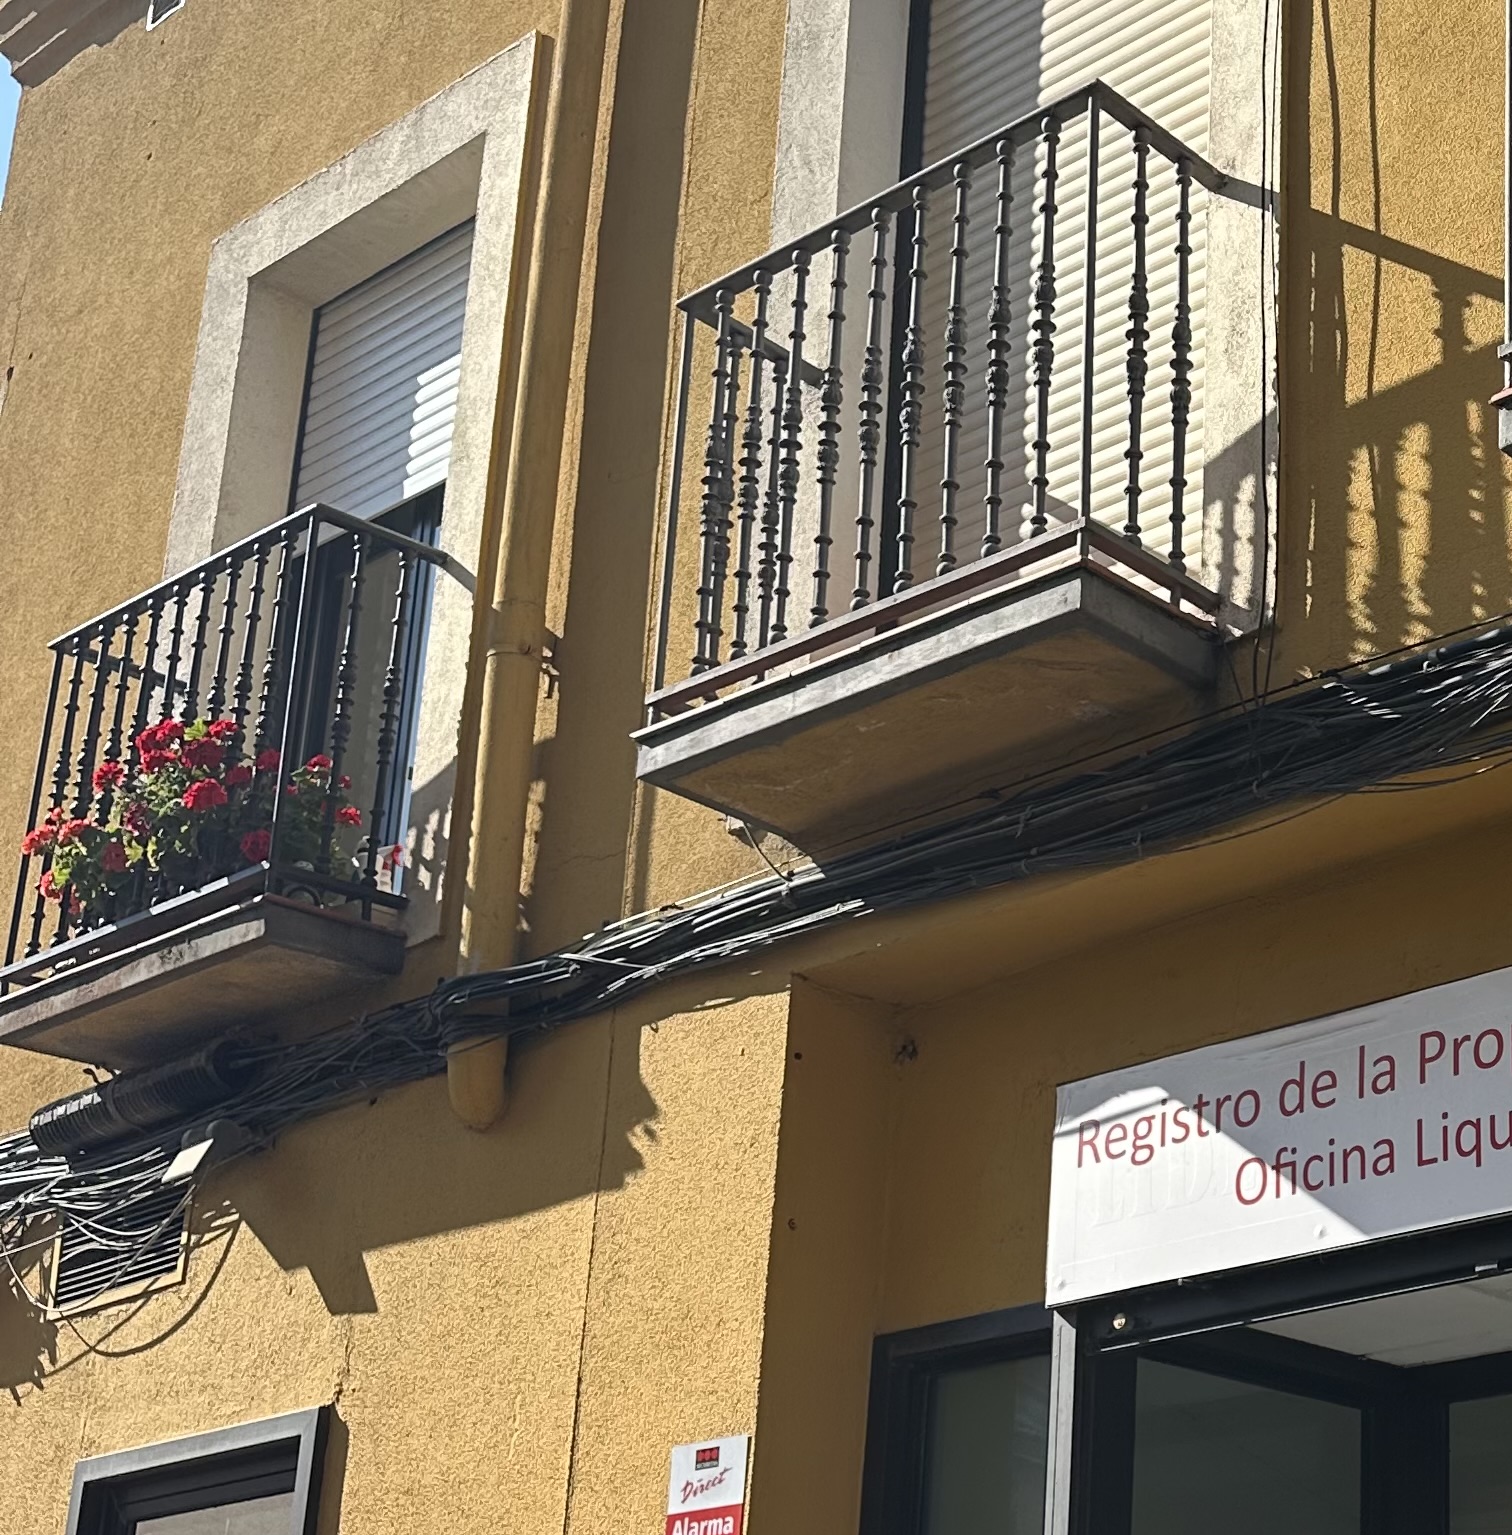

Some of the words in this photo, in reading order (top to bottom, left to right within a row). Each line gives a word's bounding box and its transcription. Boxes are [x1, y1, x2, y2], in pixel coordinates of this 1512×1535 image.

[1077, 1089, 1261, 1168] Registro
[1278, 1060, 1338, 1118] de
[1358, 1045, 1396, 1100] la
[1235, 1137, 1396, 1206] Oficina
[681, 1466, 733, 1505] Direct
